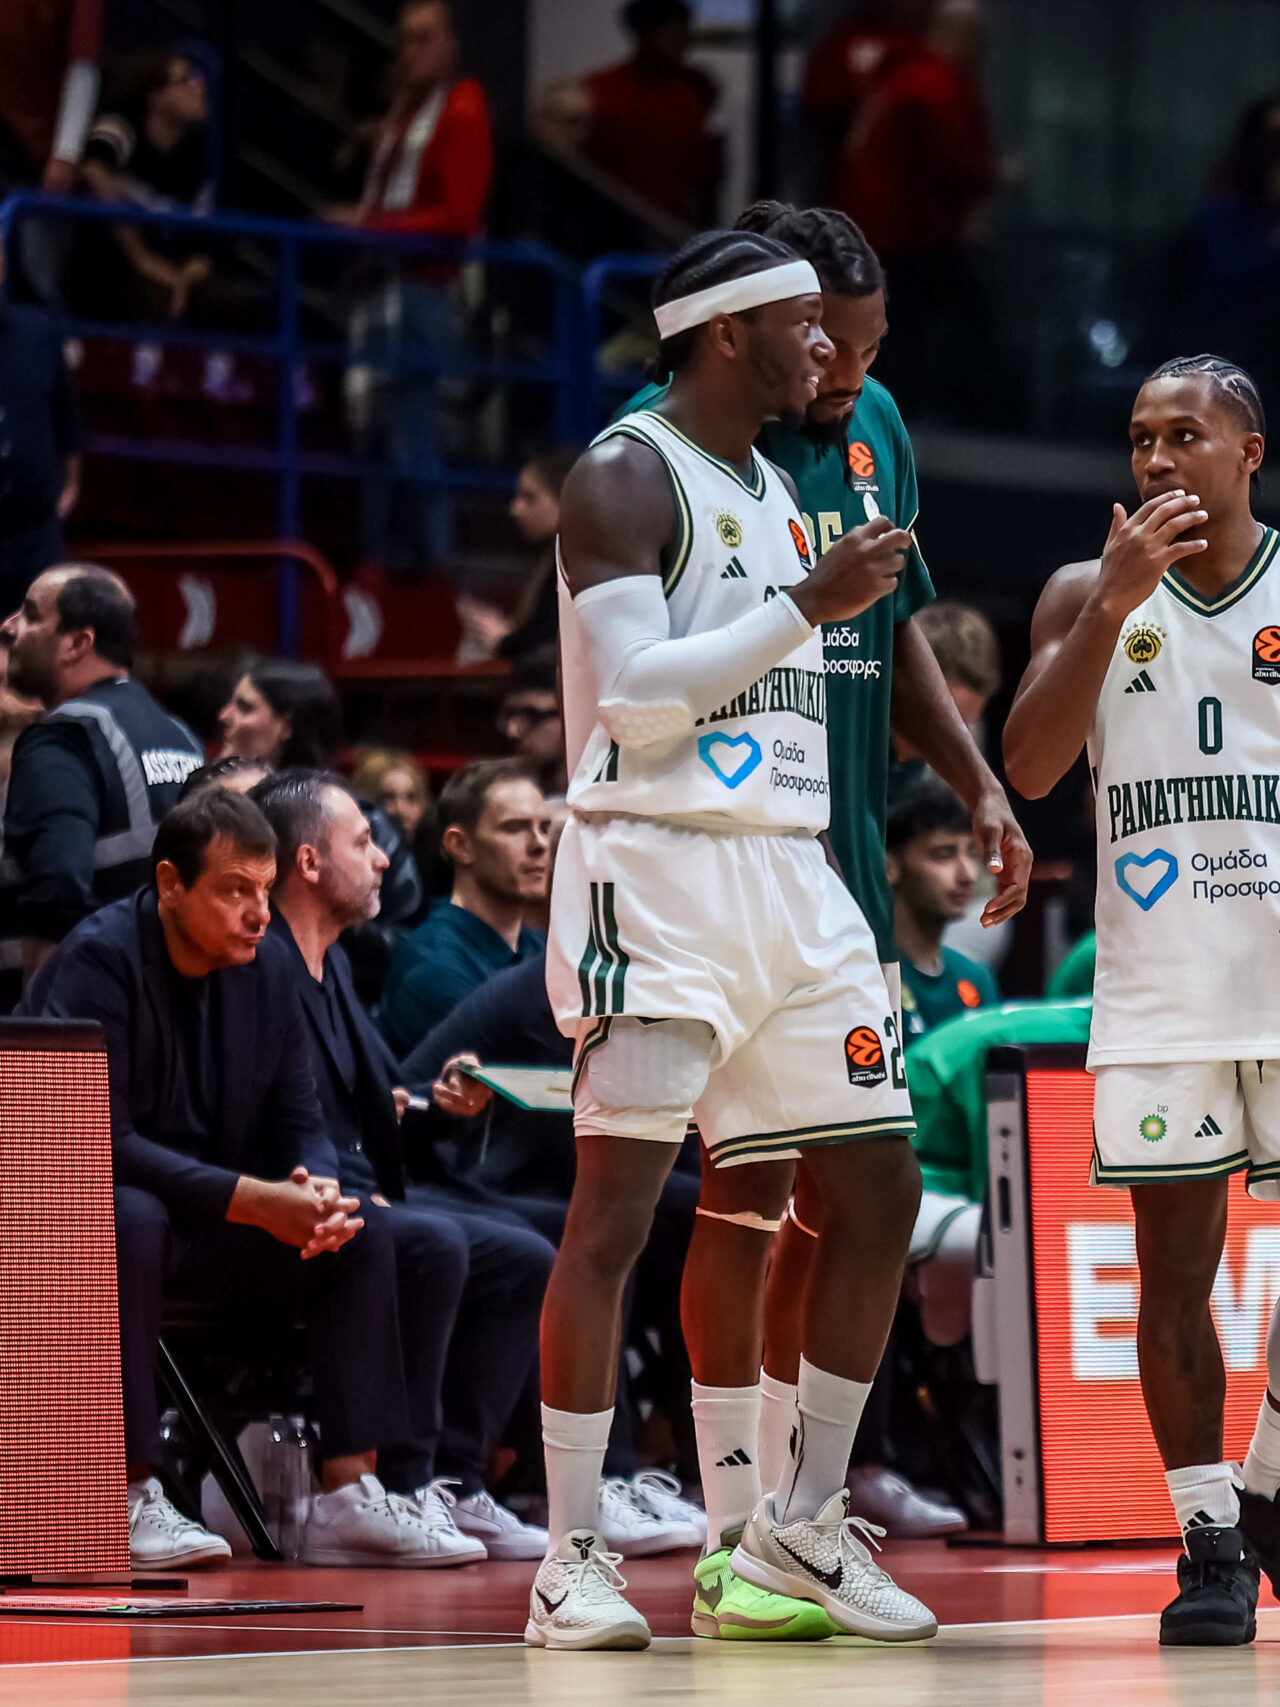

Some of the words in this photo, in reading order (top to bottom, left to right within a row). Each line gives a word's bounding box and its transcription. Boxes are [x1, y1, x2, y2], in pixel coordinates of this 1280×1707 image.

[1198, 696, 1223, 755] 0
[1191, 848, 1267, 876] Ομάδα
[883, 1014, 908, 1089] 2
[1157, 1103, 1169, 1114] bp
